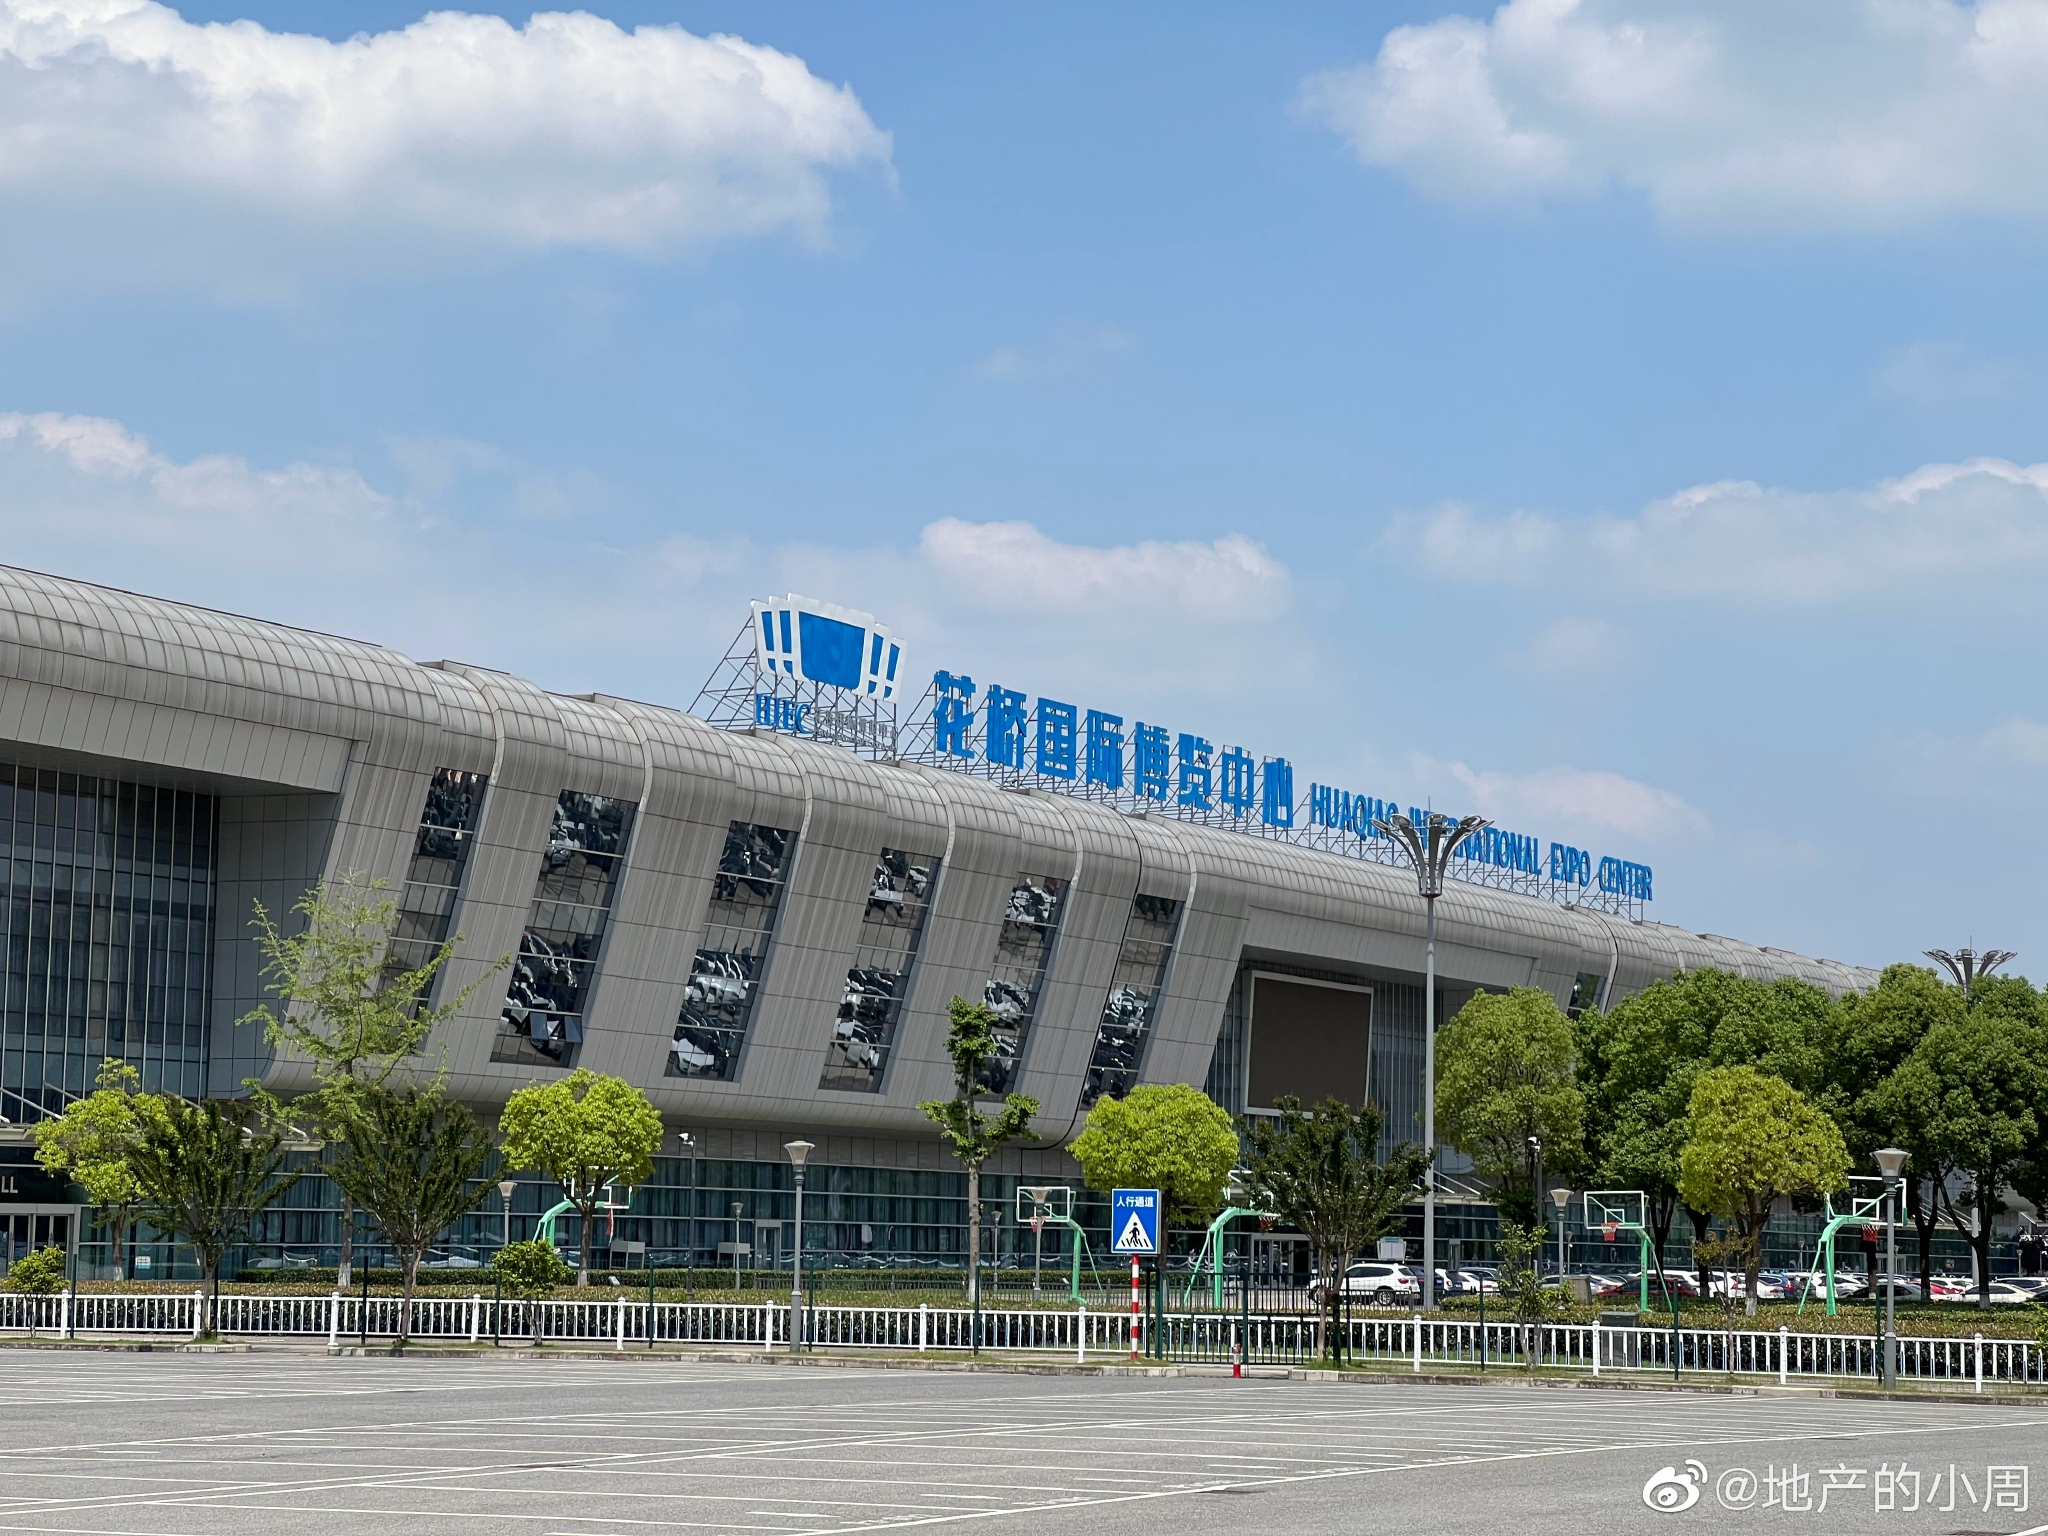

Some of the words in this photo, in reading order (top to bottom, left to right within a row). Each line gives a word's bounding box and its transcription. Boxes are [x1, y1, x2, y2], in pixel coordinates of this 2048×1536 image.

[933, 669, 1293, 828] 花桥国际博览中心
[1310, 782, 1399, 843] HUAQIAO
[1550, 842, 1590, 887] EXPO
[1598, 856, 1652, 901] CENTER
[1116, 1195, 1154, 1208] 人行通道
